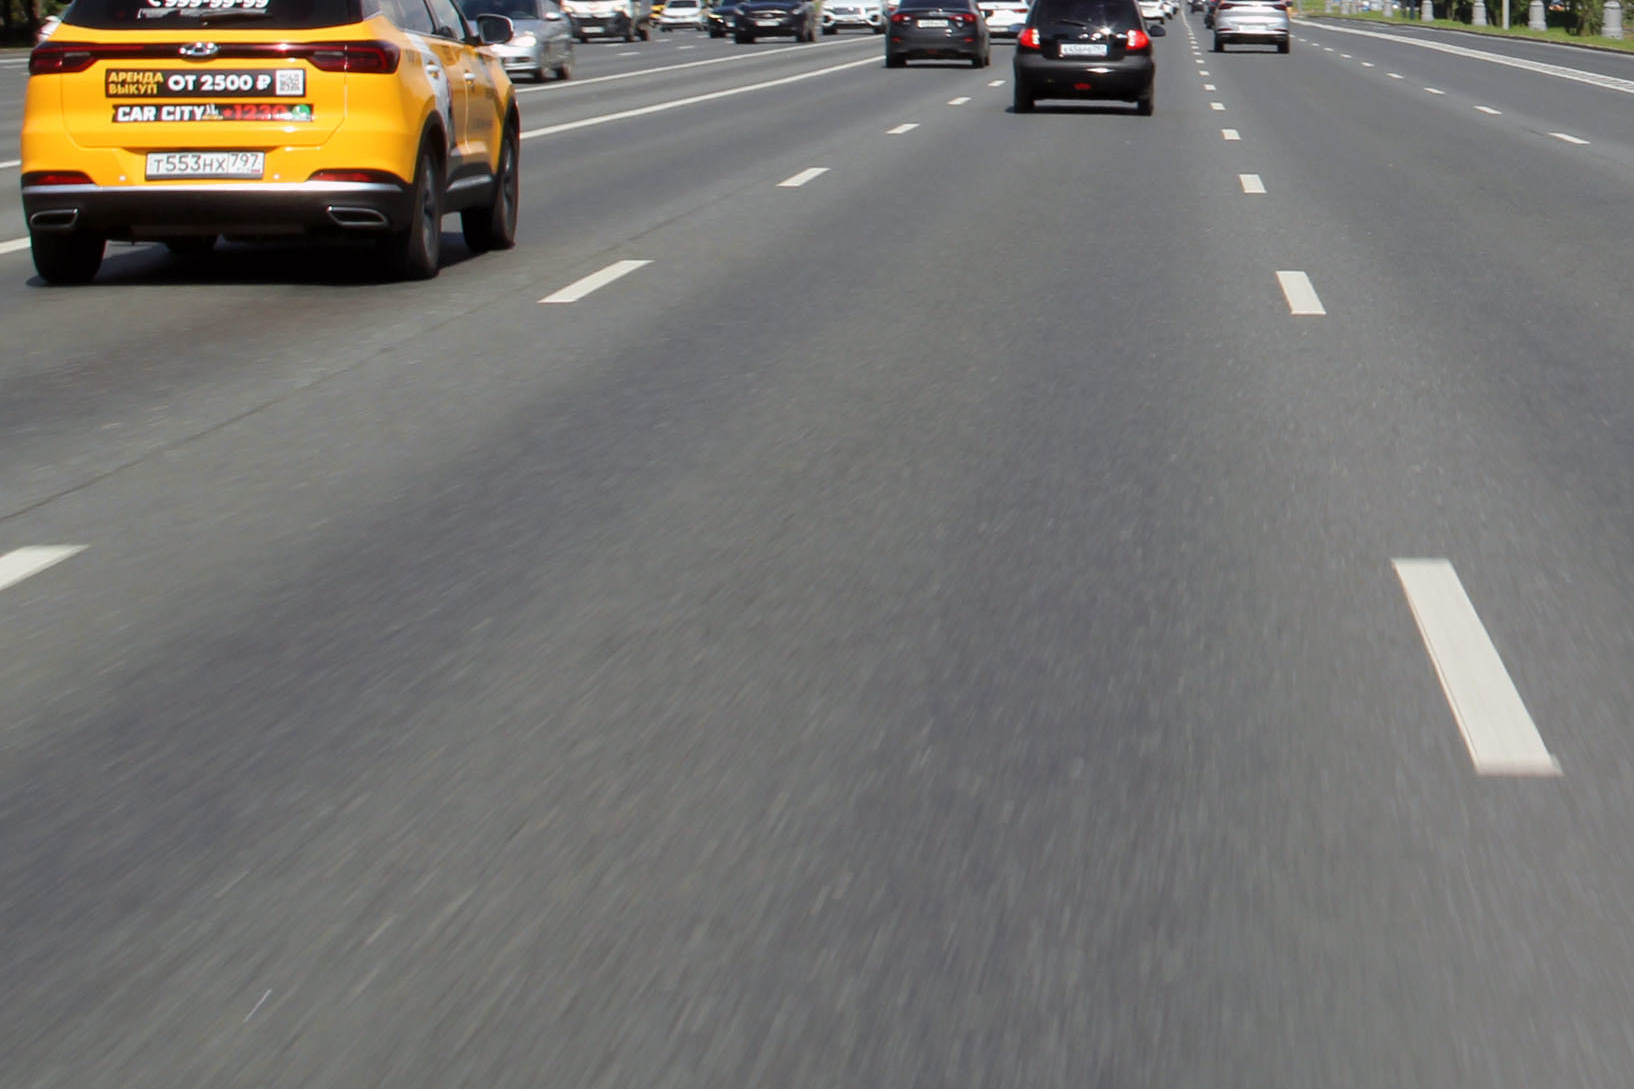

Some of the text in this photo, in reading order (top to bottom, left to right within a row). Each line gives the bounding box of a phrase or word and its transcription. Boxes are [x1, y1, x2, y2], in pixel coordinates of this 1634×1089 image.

[108, 72, 164, 83] АРЕНДА
[167, 75, 197, 91] ОТ
[200, 75, 253, 91] 2500
[108, 83, 158, 95] ВЫКУП
[116, 106, 205, 121] CAR CITY
